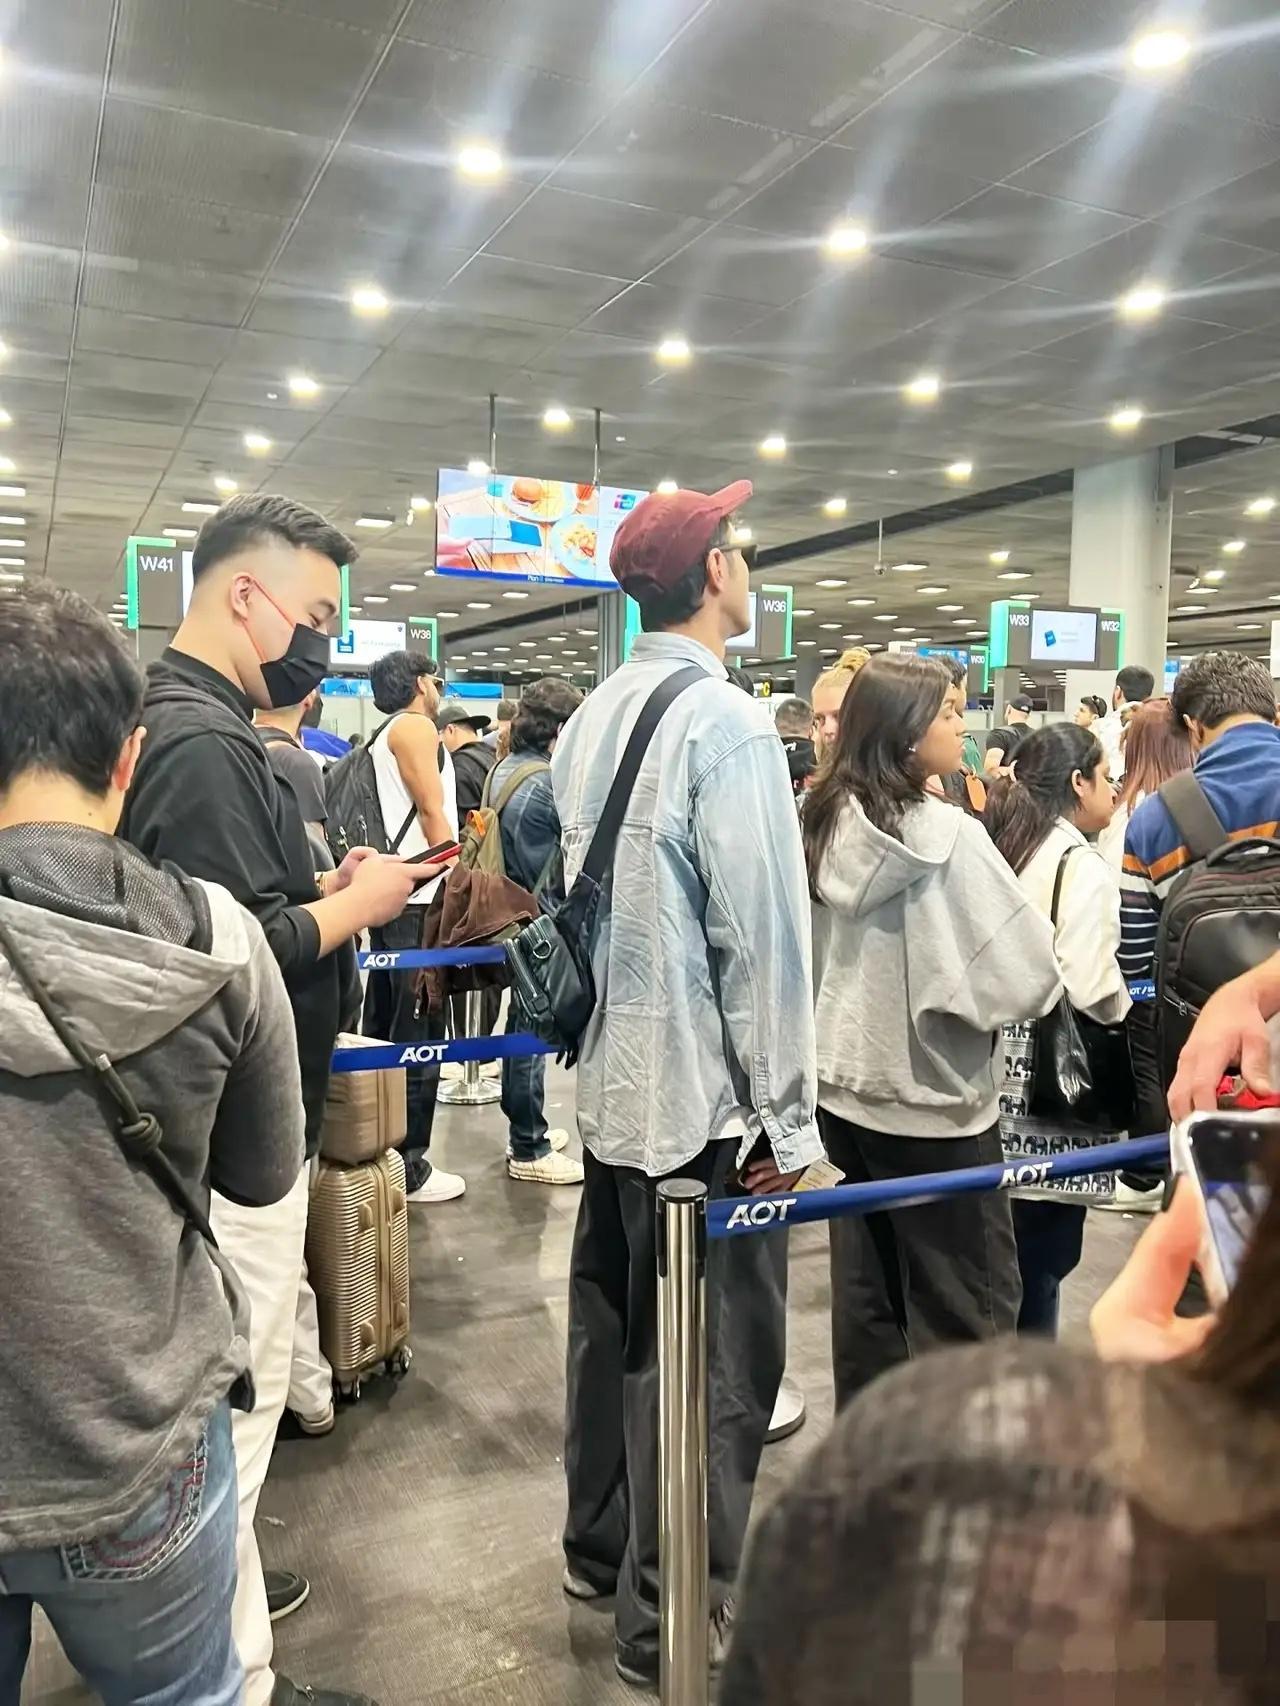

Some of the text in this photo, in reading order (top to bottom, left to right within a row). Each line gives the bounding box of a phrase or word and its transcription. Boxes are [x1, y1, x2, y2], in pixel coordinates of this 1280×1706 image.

[140, 555, 174, 572] W41
[763, 599, 787, 612] W36
[1009, 614, 1030, 626] W33
[1101, 620, 1120, 632] W32
[362, 953, 401, 968] AOT
[398, 1044, 449, 1064] AOT
[996, 1161, 1053, 1190] AOT
[726, 1198, 798, 1230] AOT
